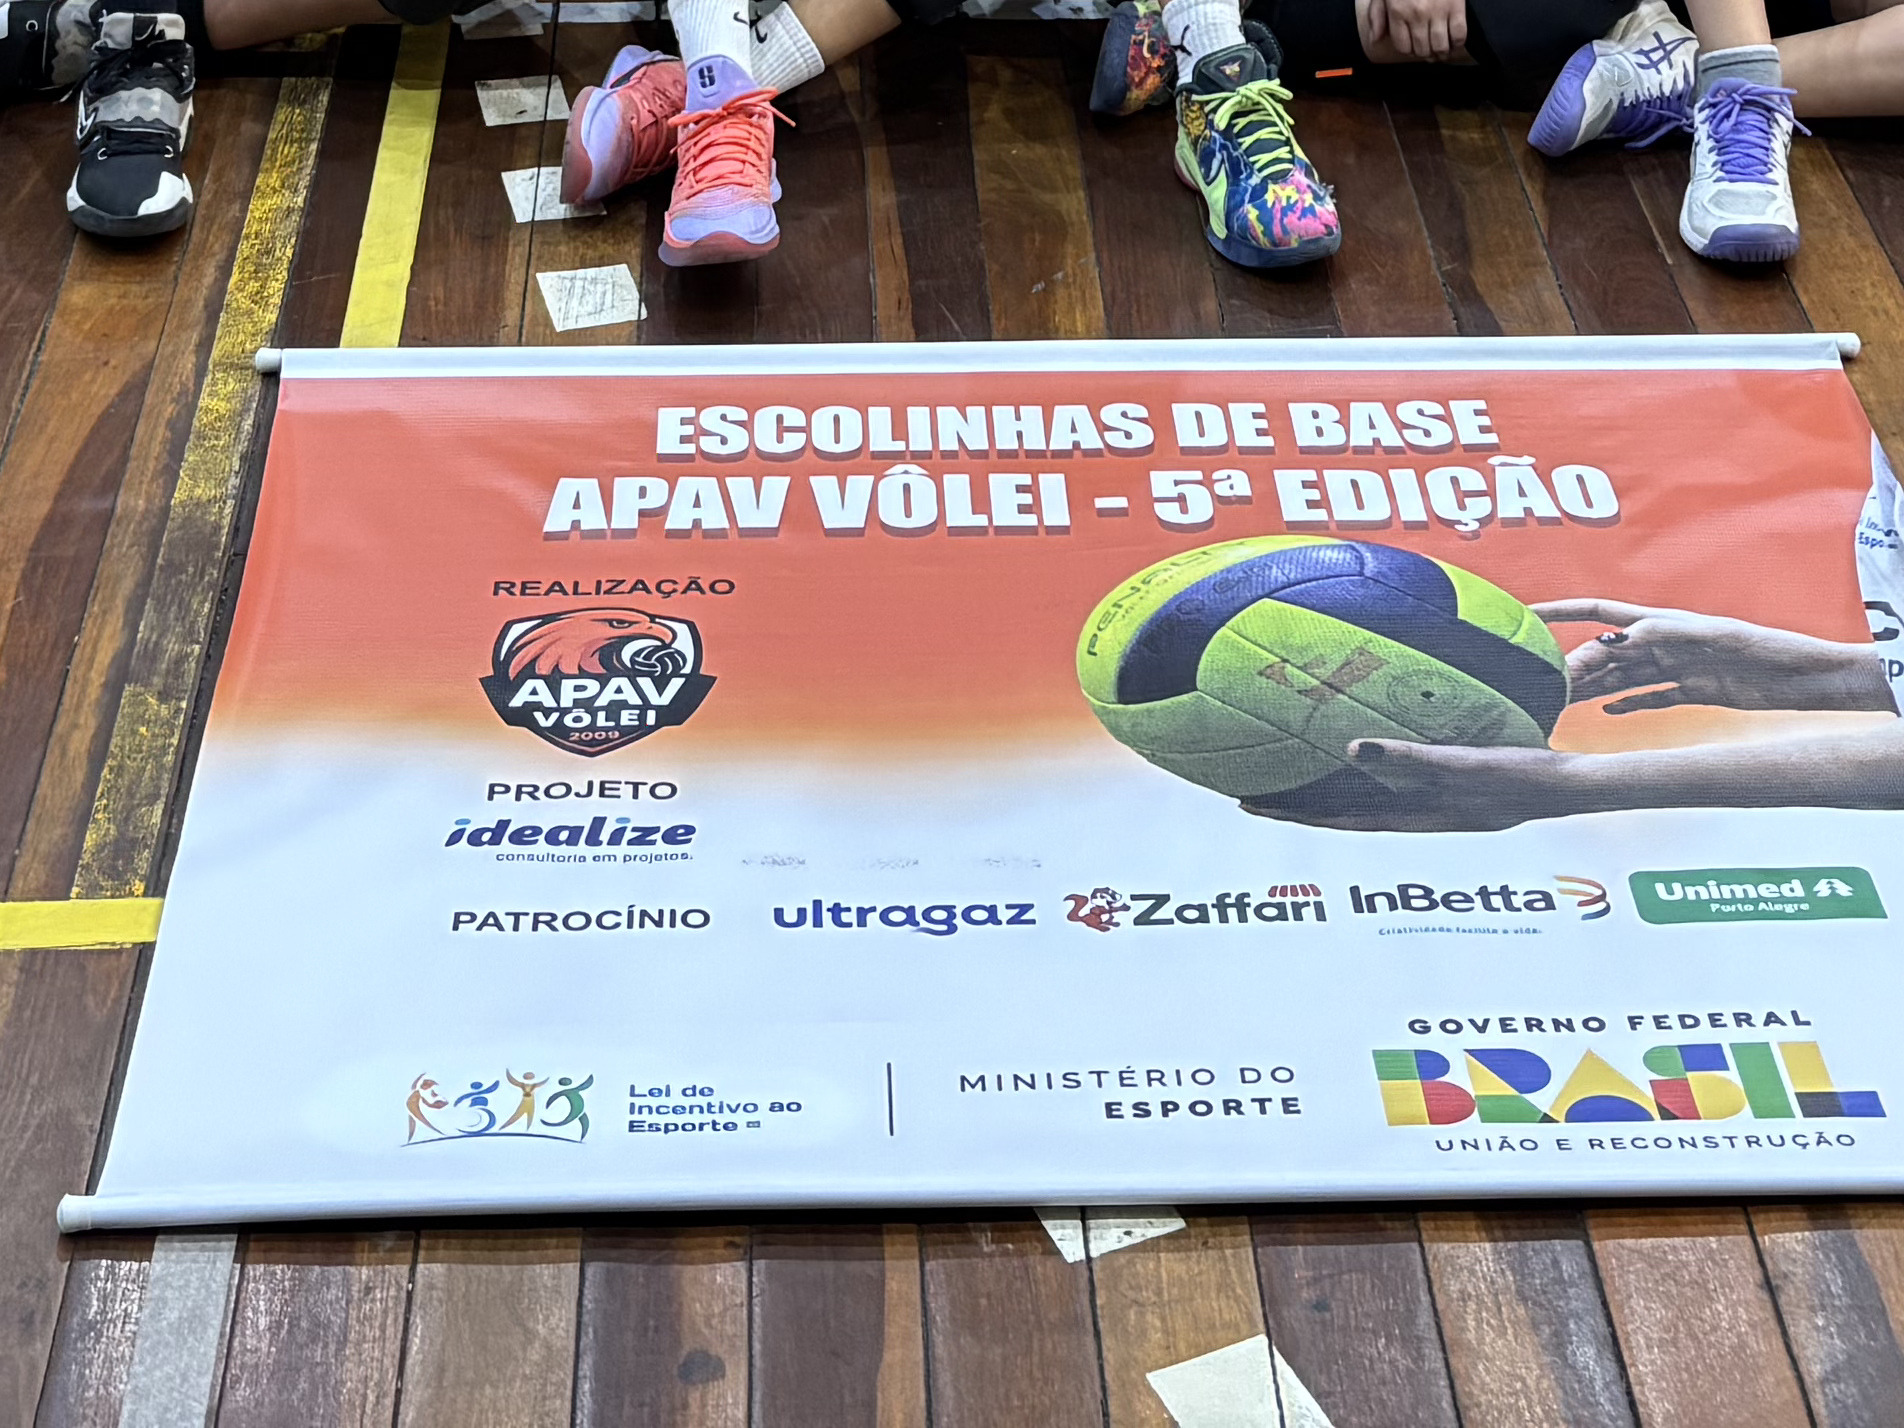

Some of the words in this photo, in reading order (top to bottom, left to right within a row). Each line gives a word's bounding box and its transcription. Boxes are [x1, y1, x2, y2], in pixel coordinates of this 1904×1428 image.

[657, 402, 1154, 456] ESCOLINHAS
[1173, 402, 1274, 449] DE
[1295, 398, 1499, 451] BASE
[543, 475, 791, 535] APAV
[810, 464, 1070, 533] VÔLEI
[1276, 456, 1619, 533] EDIÇÃO
[492, 577, 736, 599] REALIZAÇÃO
[510, 677, 685, 707] APAV
[533, 708, 656, 728] VÔLEI
[569, 731, 620, 740] 2009
[487, 781, 678, 801] PROJETO
[445, 817, 696, 846] idealize
[496, 852, 587, 864] consultoria
[593, 853, 618, 863] em
[1350, 883, 1556, 914] InBetta
[1654, 879, 1804, 901] Unimed
[1130, 884, 1327, 925] Zaffari
[1710, 901, 1753, 913] Porto
[1758, 900, 1809, 912] Alegre
[452, 905, 711, 932] PATROCÍNIO
[774, 900, 1036, 936] ultragaz
[1407, 1016, 1607, 1035] GOVERNO
[1628, 1010, 1812, 1031] FEDERAL
[959, 1065, 1216, 1092] MINISTÉRIO
[1240, 1066, 1295, 1084] DO
[1372, 1041, 1887, 1126] BRASIL
[629, 1085, 671, 1098] Lei
[681, 1085, 715, 1098] de
[629, 1100, 758, 1116] Incentivo
[768, 1100, 802, 1113] ao
[1105, 1096, 1303, 1120] ESPORTE
[629, 1119, 738, 1134] Esporte
[1436, 1133, 1538, 1152] UNIÃO
[1556, 1138, 1573, 1150] E
[1589, 1130, 1856, 1151] RECONSTRUÇÃO
